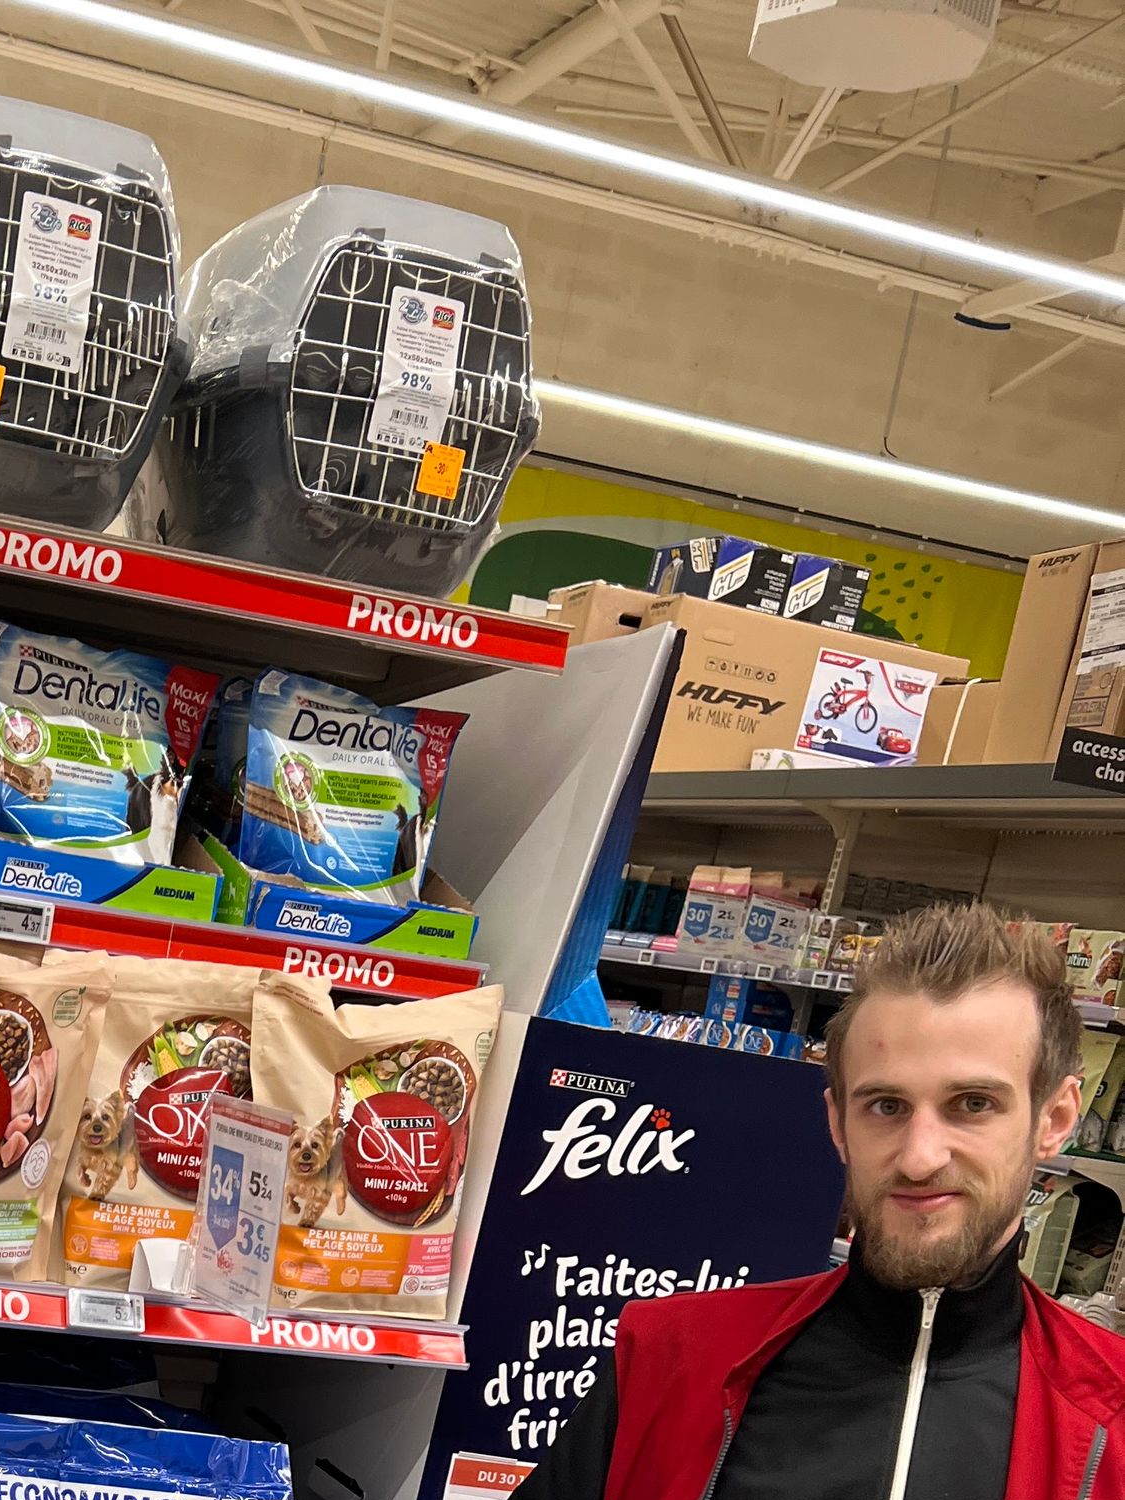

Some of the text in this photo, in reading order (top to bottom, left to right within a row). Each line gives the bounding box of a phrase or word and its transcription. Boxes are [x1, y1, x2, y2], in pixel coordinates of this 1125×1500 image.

[69, 218, 92, 234] RIGA
[33, 284, 68, 304] 98%
[433, 309, 455, 324] RIGA
[401, 371, 432, 391] 98%
[1038, 553, 1081, 568] HUFFY
[346, 594, 479, 648] PROMO
[13, 659, 161, 721] Dentalife
[170, 682, 209, 705] Maxi
[676, 682, 786, 715] HUFFY
[61, 706, 112, 724] DAILY ORAL
[173, 700, 202, 719] Pack
[687, 704, 761, 734] WE MAKE FUN
[175, 717, 191, 732] 15
[289, 709, 418, 763] Dentalife
[332, 752, 385, 766] DAILY ORAL
[2, 867, 83, 897] Dentalife
[154, 886, 195, 901] MEDIUM
[279, 910, 351, 937] Dentalife
[417, 925, 455, 939] MEDIUM
[283, 947, 395, 988] PROMO
[567, 1073, 629, 1096] PURINA
[384, 1119, 433, 1129] PURINA
[358, 1125, 442, 1168] ONE
[520, 1098, 696, 1196] felix
[99, 1203, 161, 1217] PEAU SAINE
[93, 1212, 176, 1230] PELAGE SOYEUX
[303, 1238, 384, 1254] PELAGE SOYEUX
[308, 1230, 369, 1243] PEAU SAINE
[251, 1318, 376, 1353] PROMO
[477, 1470, 516, 1486] DU 30
